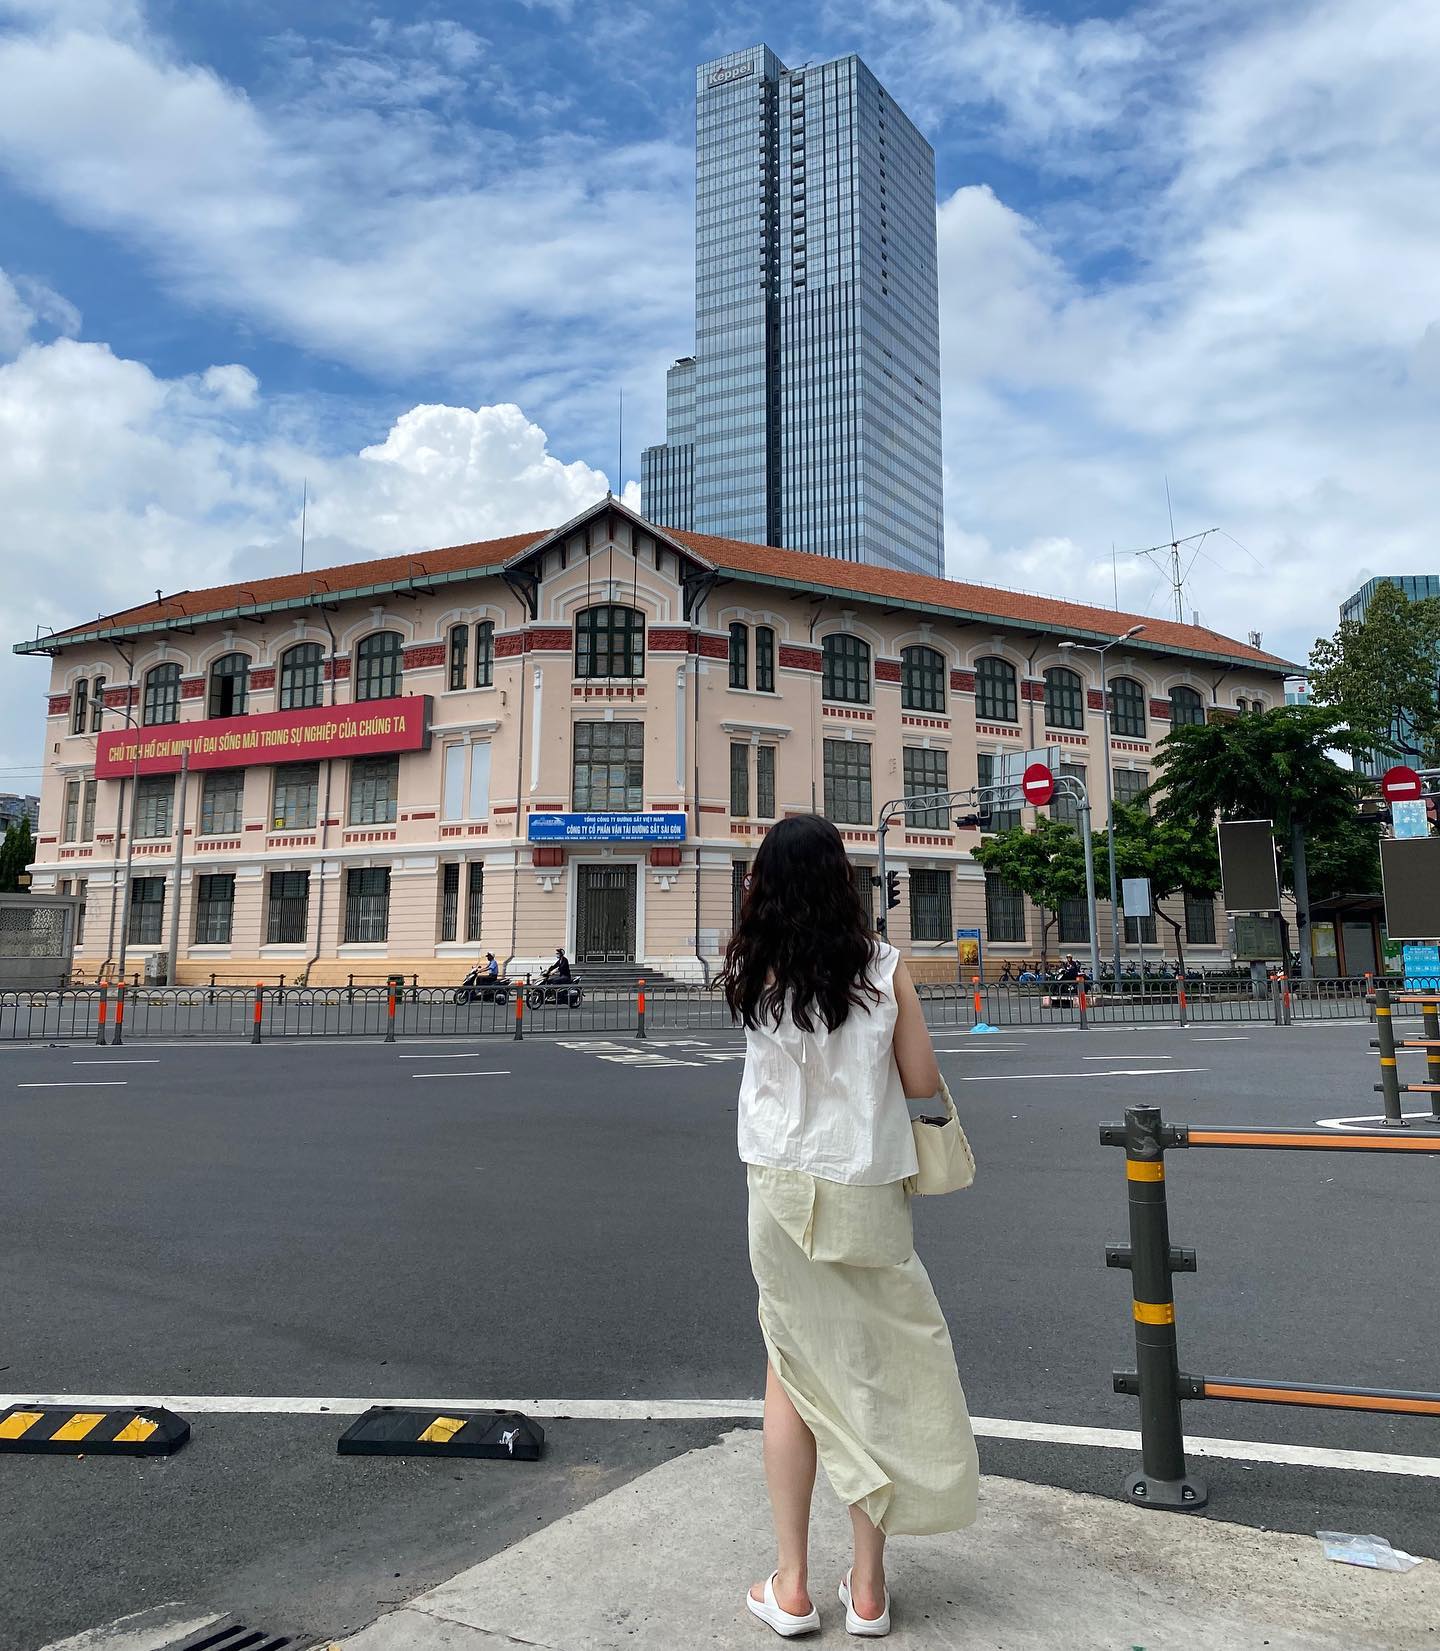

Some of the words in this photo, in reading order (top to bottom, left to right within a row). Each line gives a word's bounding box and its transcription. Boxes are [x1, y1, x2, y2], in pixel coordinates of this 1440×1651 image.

[709, 62, 751, 84] Keppel
[109, 742, 124, 762] CHỦ
[126, 744, 143, 763] TỊCH
[157, 739, 171, 757] CHÍ
[193, 735, 204, 753] VĨ
[203, 736, 217, 755] ĐẠI
[218, 730, 241, 751] SỐNG
[242, 730, 259, 748] MÃI
[261, 730, 289, 747] TRONG
[290, 726, 303, 747] SỰ
[304, 721, 337, 743] NGHIỆP
[338, 717, 357, 739] CỦA
[359, 716, 391, 737] CHÚNG
[393, 716, 406, 733] TA
[566, 824, 581, 834] CÔNG
[581, 826, 588, 834] TY
